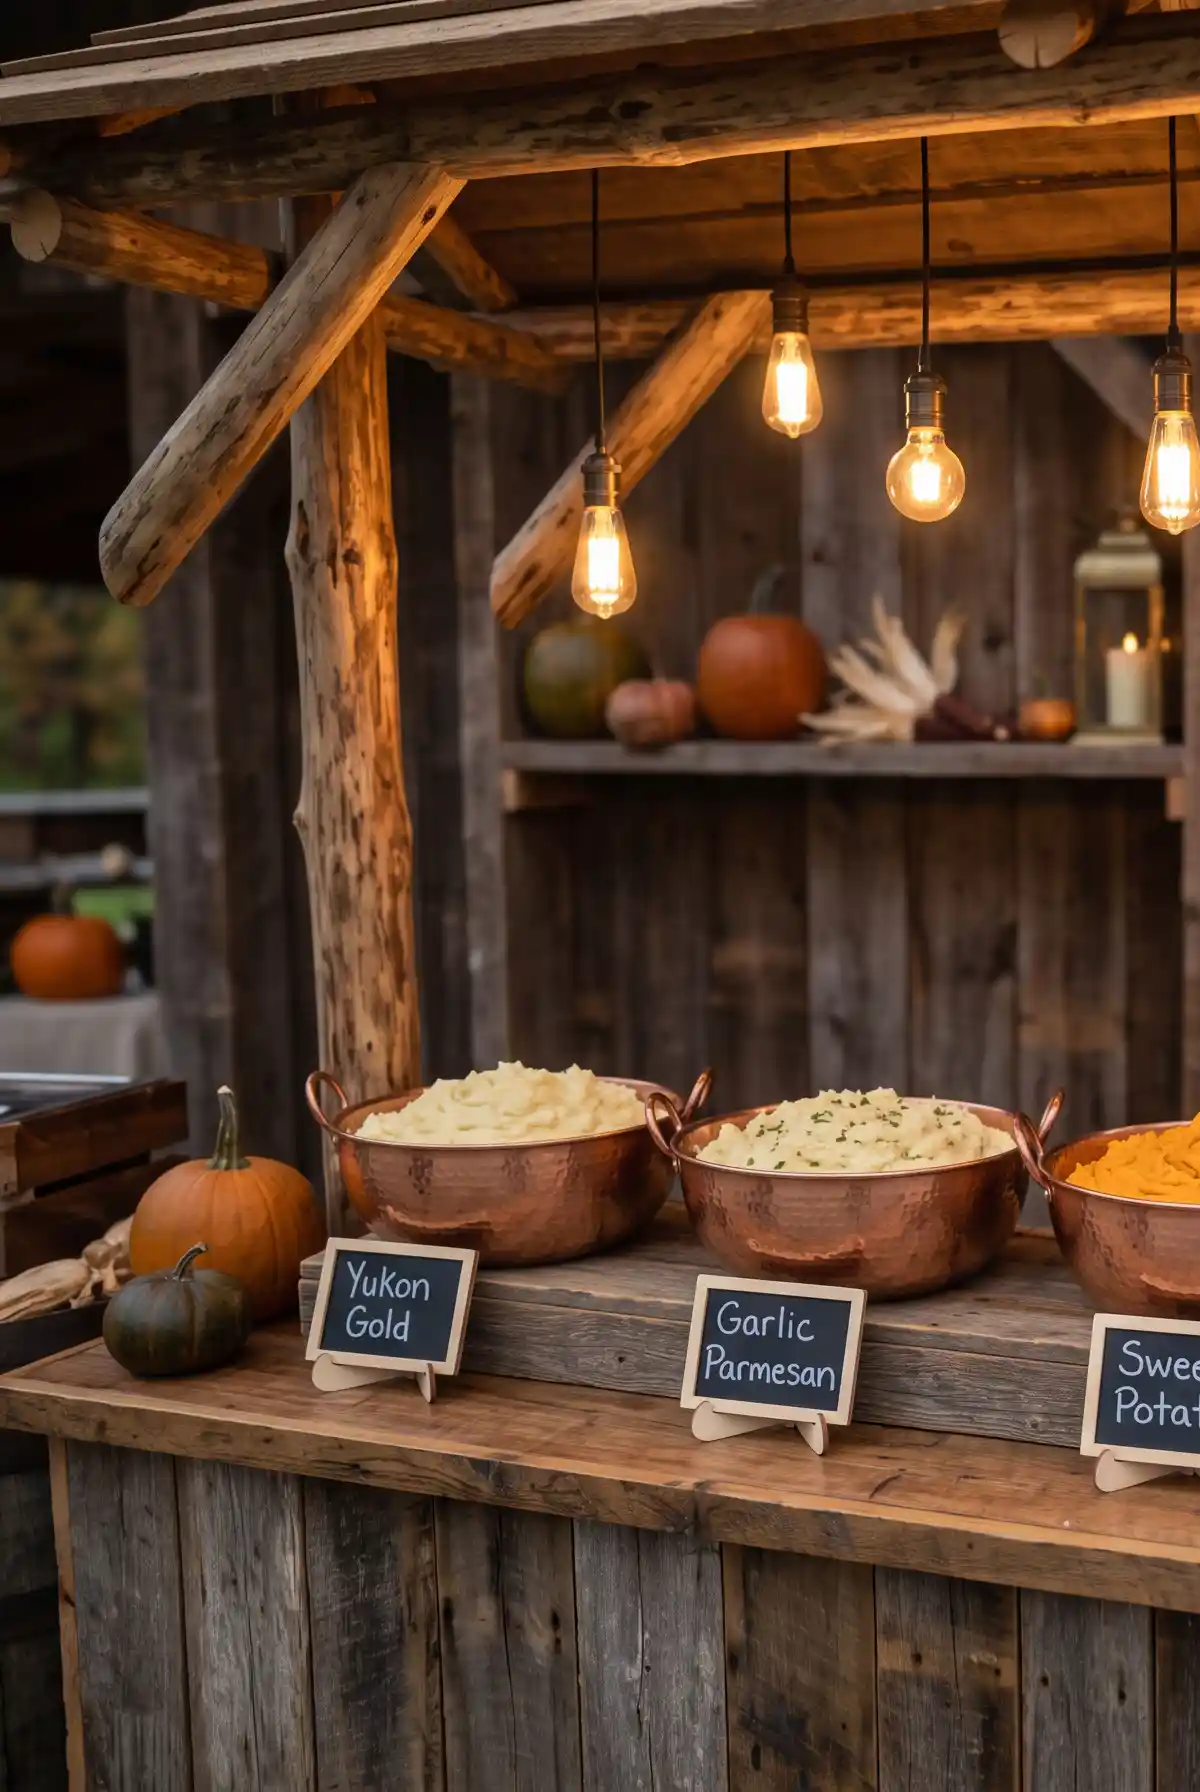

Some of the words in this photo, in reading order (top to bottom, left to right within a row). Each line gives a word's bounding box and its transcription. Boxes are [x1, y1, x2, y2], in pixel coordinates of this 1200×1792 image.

[345, 1304, 410, 1342] Gold
[716, 1300, 815, 1342] Garlic
[703, 1343, 836, 1391] Parmesan
